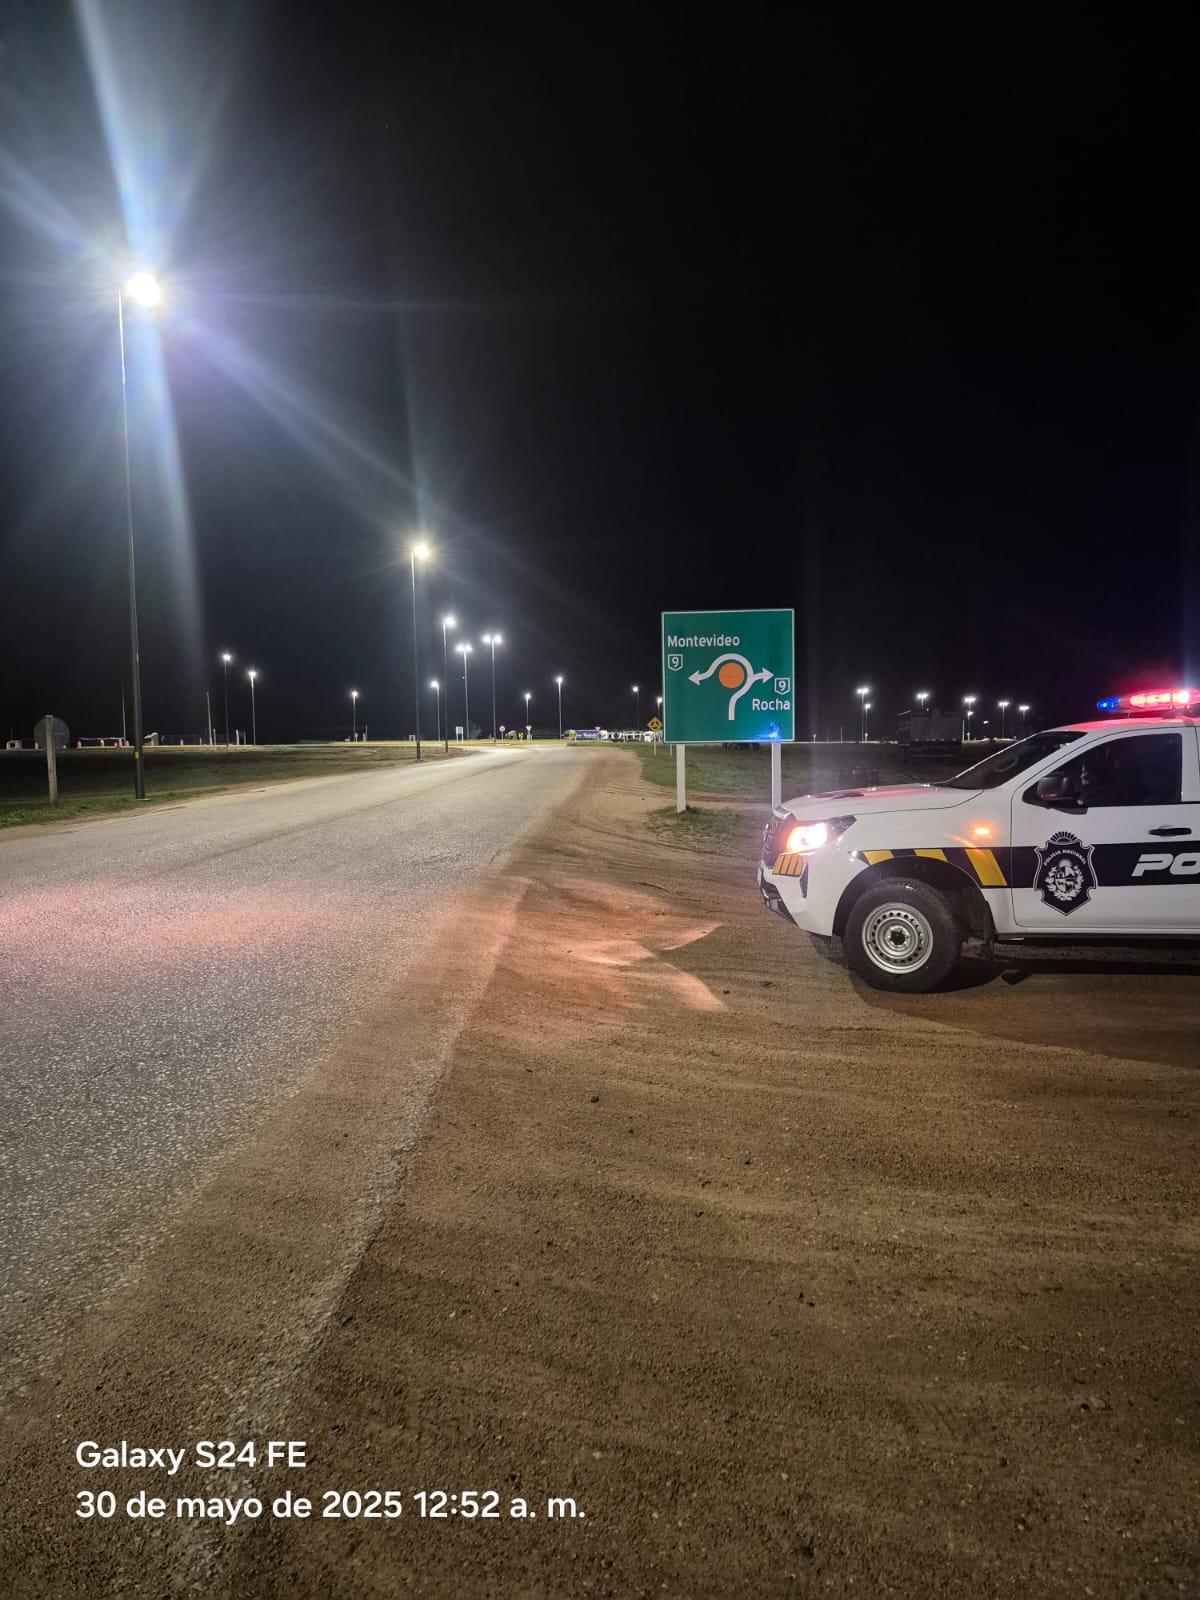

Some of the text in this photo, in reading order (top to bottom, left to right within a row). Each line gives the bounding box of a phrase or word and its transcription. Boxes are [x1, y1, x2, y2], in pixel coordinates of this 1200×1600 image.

[667, 634, 740, 648] Montevideo
[671, 656, 679, 668] 9
[778, 680, 786, 692] 9
[752, 698, 790, 711] Rocha
[1062, 849, 1087, 865] NACIONAL
